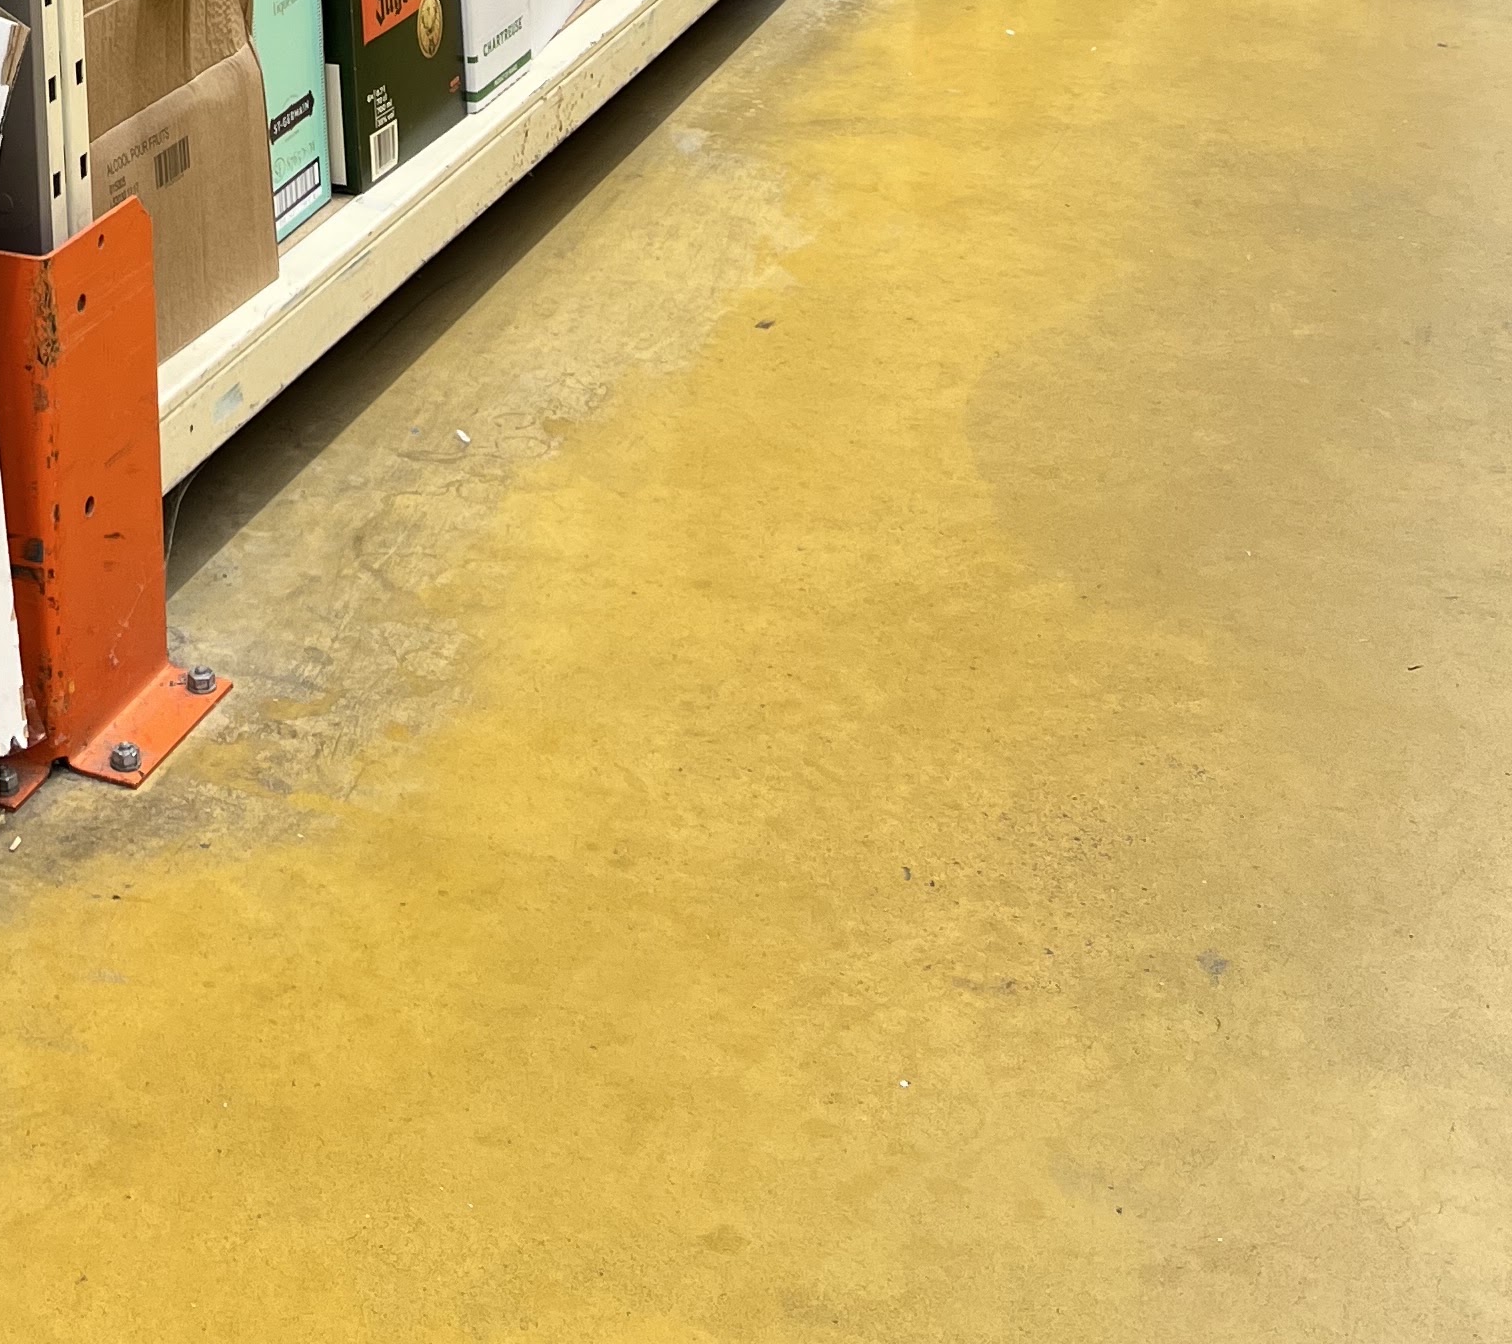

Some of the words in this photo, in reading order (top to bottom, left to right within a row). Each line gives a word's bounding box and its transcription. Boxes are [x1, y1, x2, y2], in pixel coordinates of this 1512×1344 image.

[482, 15, 524, 58] CHARTREUSE
[106, 153, 130, 177] ALCOOL
[129, 140, 148, 163] POUR
